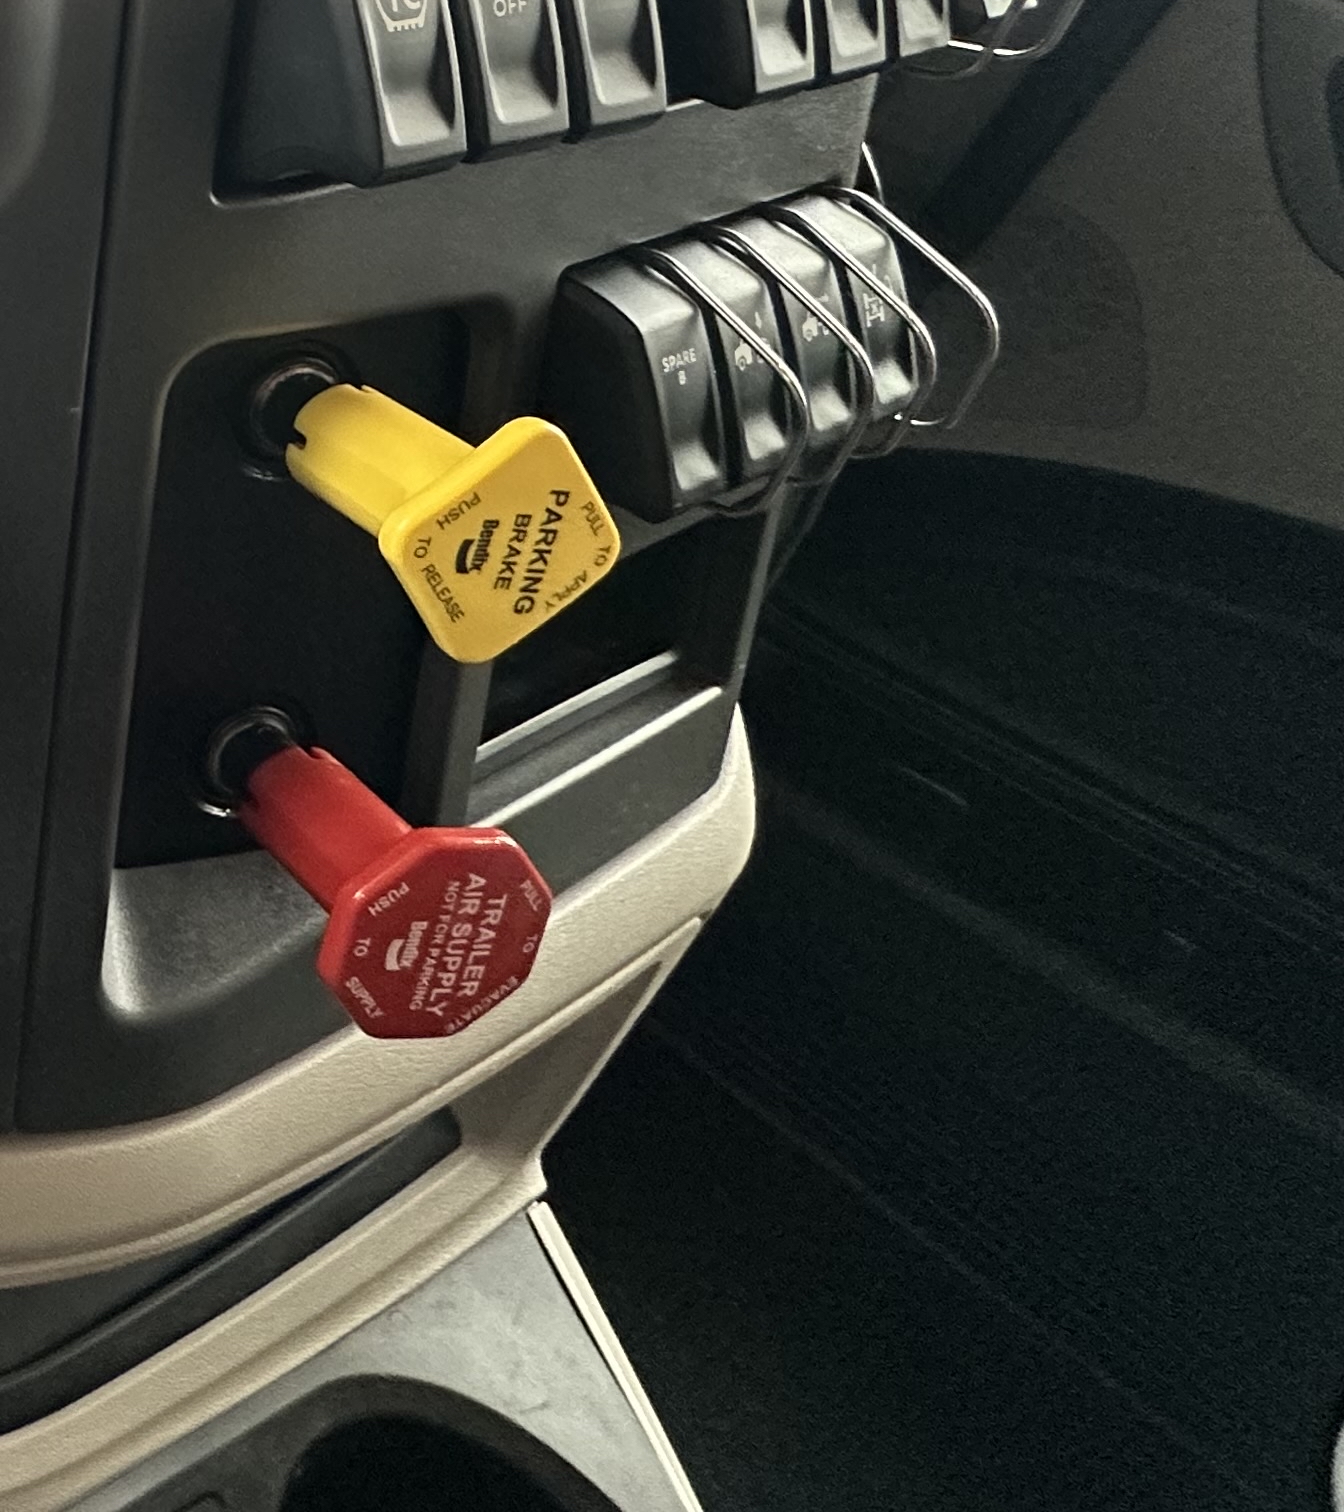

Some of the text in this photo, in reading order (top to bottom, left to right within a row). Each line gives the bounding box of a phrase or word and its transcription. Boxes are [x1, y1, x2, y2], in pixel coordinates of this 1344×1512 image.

[662, 347, 697, 373] SPARE
[413, 492, 482, 623] PUSH TO RELEASE
[469, 519, 500, 575] Bendix
[493, 513, 532, 590] BRAKE
[513, 489, 570, 615] PARKING
[543, 501, 612, 613] PULL TO APPLY
[399, 920, 428, 968] Bendix
[409, 880, 460, 1011] NOT FOR PARKING
[425, 872, 487, 1017] AIR SUPPLY
[457, 893, 508, 997] TRAILER
[519, 879, 545, 912] PULL
[522, 934, 540, 953] TO
[345, 882, 410, 1019] PUSH TO SUPPLY
